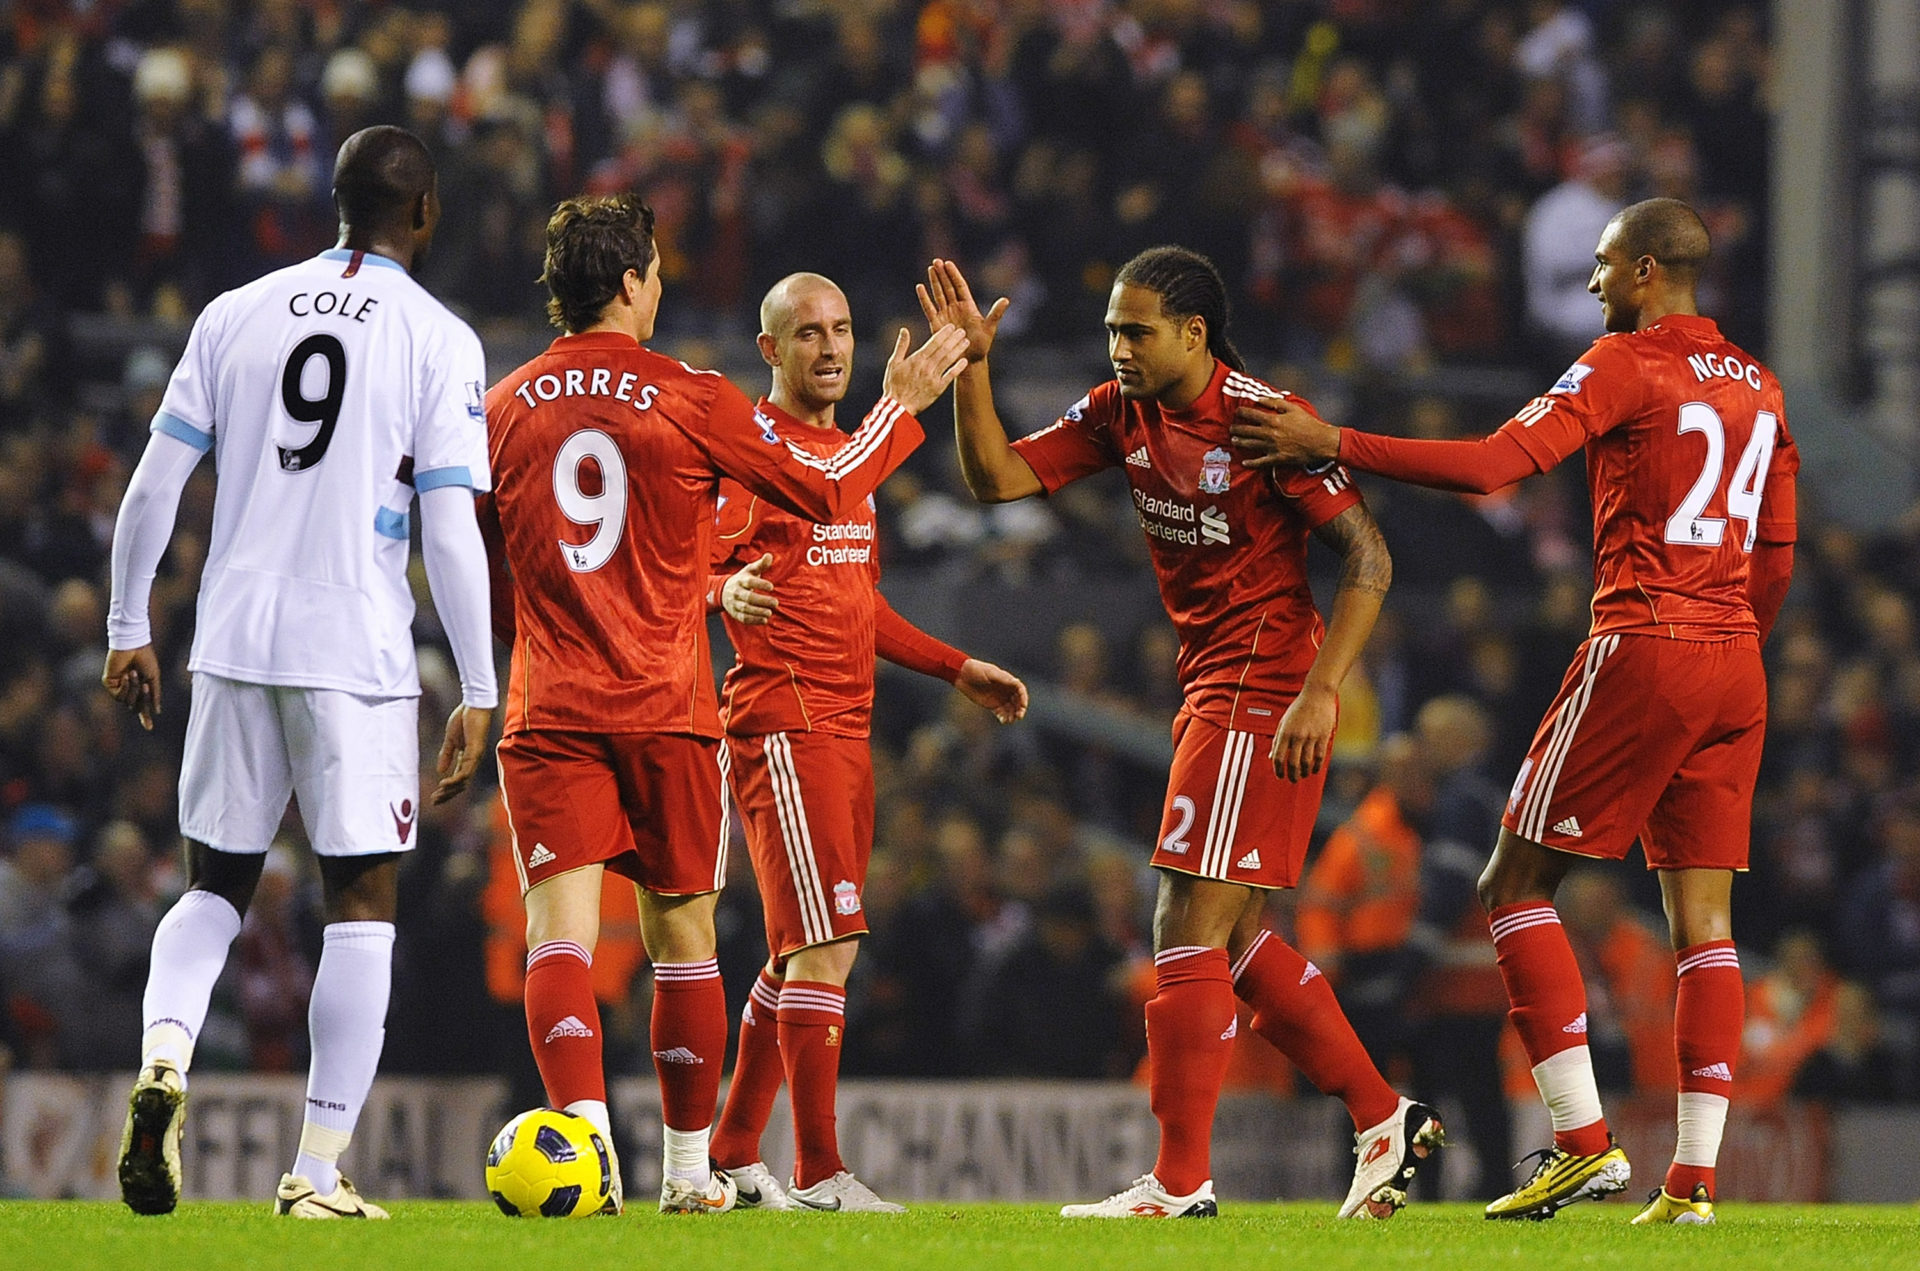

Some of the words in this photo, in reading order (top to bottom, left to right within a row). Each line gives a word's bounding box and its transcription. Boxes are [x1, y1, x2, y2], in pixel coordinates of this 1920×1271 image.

[289, 291, 379, 323] COLE
[514, 368, 660, 411] TORRES
[1687, 352, 1762, 392] NGOG
[276, 332, 347, 474] 9
[1664, 401, 1778, 553] 24
[552, 428, 628, 573] 9
[1133, 488, 1195, 522] Standard
[812, 520, 871, 542] Standard
[1161, 795, 1196, 855] 2
[308, 1098, 346, 1111] MERS
